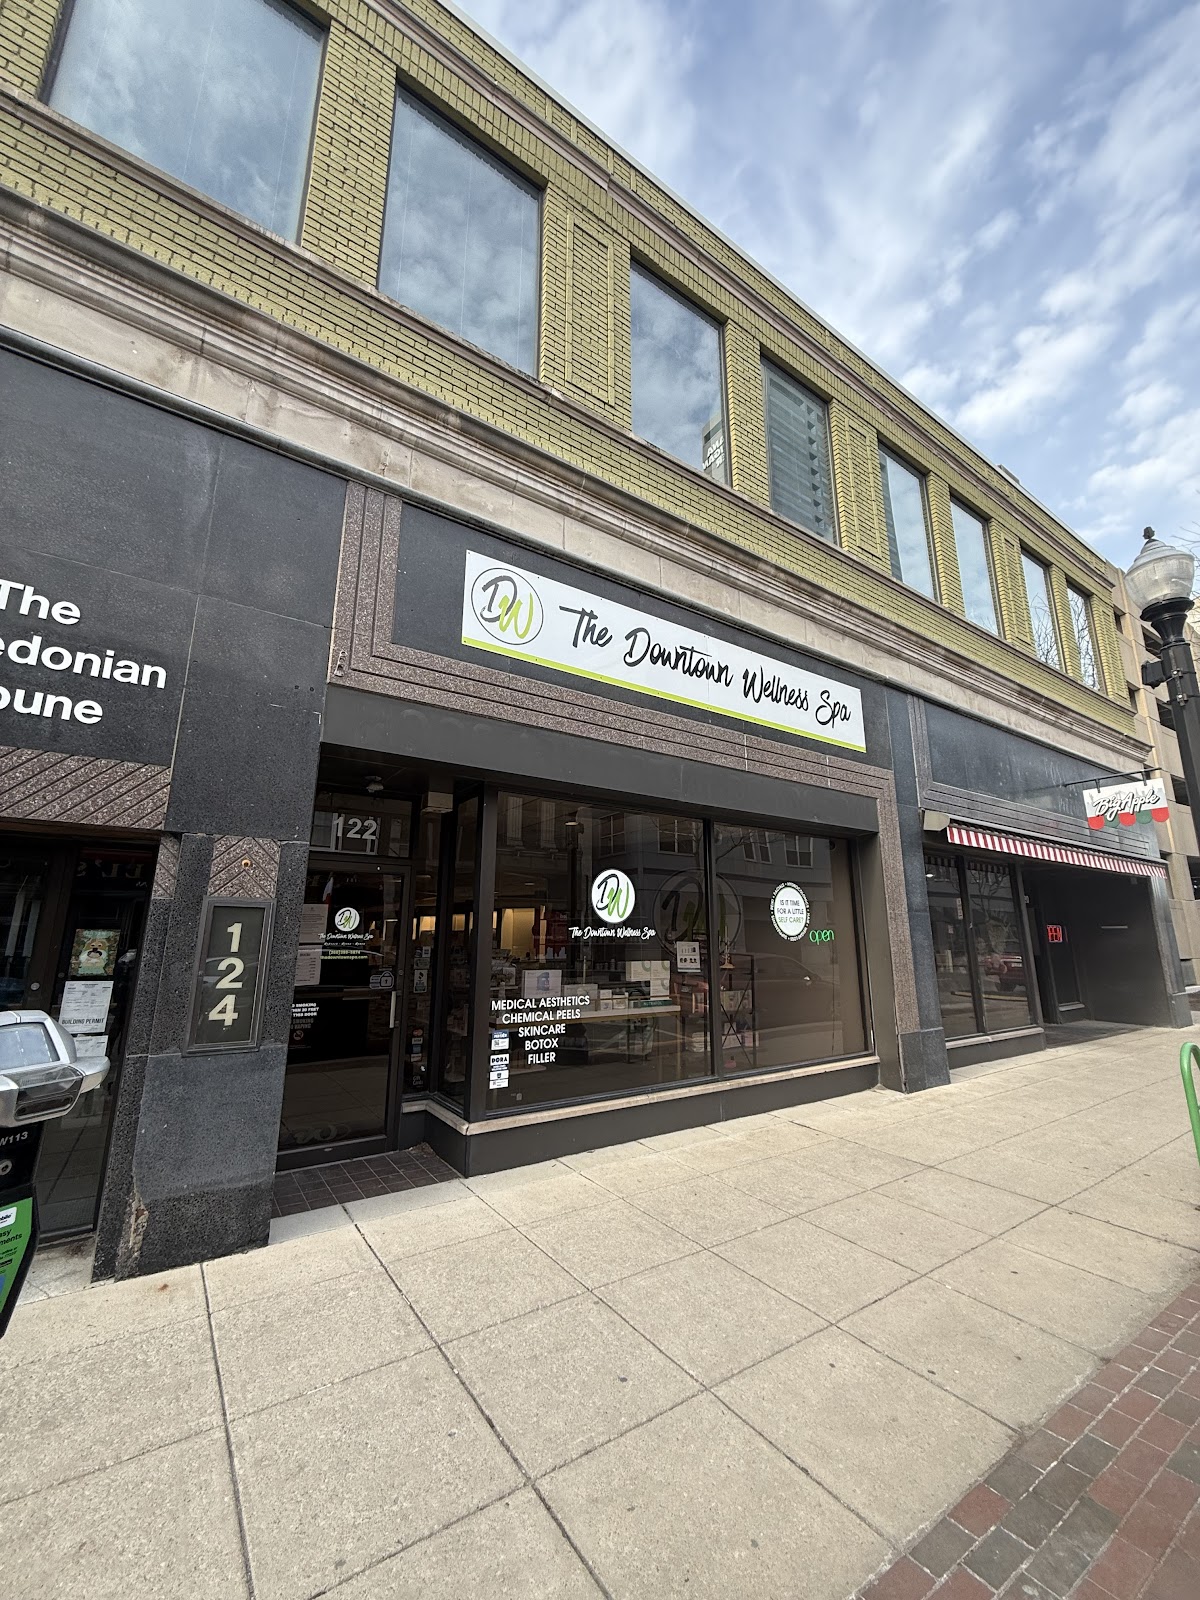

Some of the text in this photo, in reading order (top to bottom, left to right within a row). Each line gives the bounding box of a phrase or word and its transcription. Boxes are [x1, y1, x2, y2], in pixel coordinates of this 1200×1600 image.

[0, 579, 81, 625] The
[0, 635, 167, 689] donian
[559, 605, 851, 729] The Downtown Wellness Spa
[1092, 788, 1161, 821] Big Apple
[333, 816, 378, 840] 122
[568, 926, 656, 939] The Downtown Wellness Spa
[810, 930, 835, 945] open
[208, 922, 245, 1026] 124
[491, 995, 590, 1010] MEDICAL AESTHETICS
[502, 1008, 581, 1024] CHEMICAL PEELS
[518, 1023, 566, 1037] SKINCARE
[525, 1038, 559, 1050] BOTOX
[528, 1052, 556, 1064] FILLER
